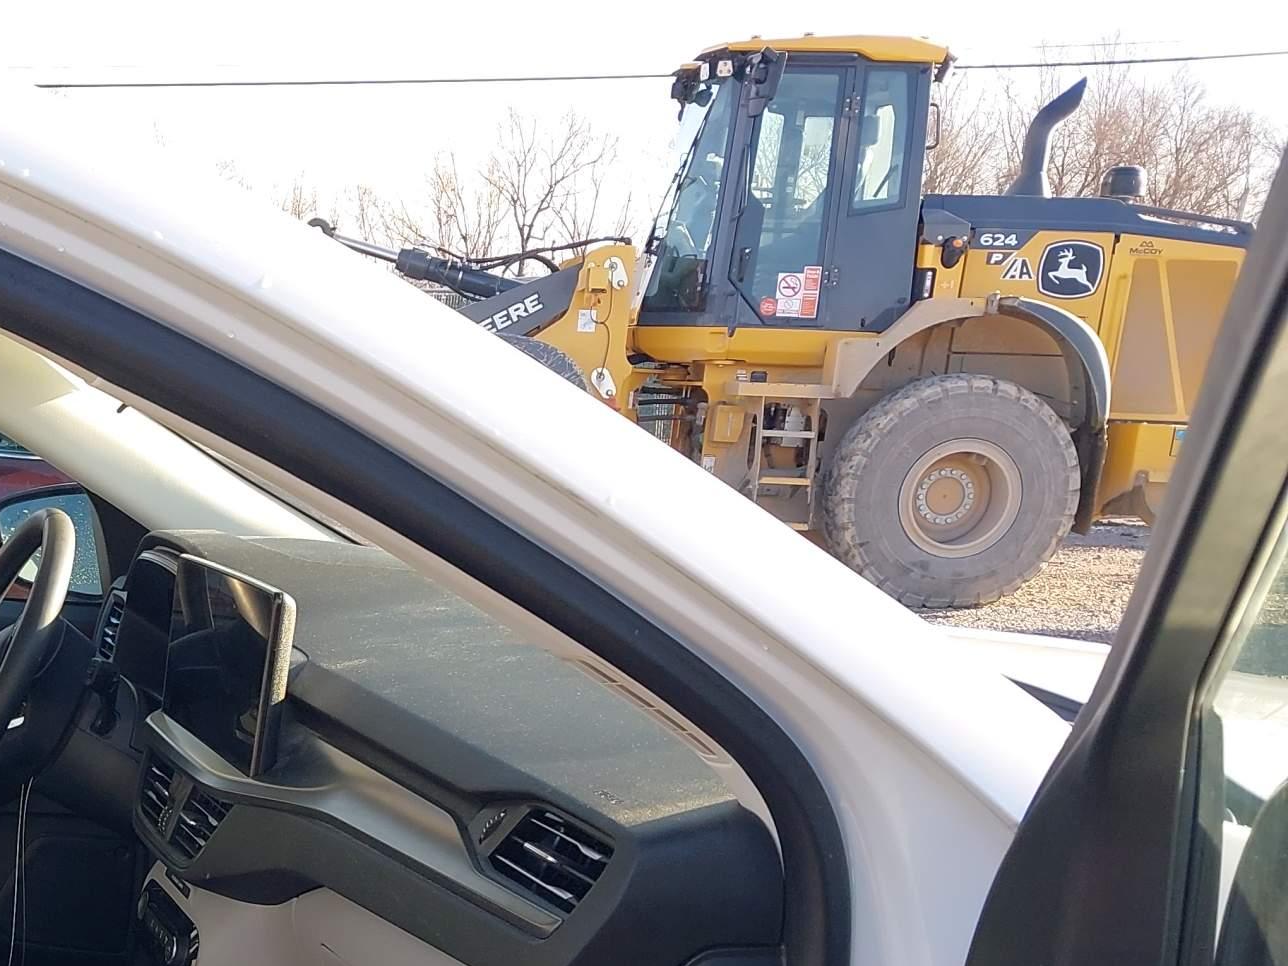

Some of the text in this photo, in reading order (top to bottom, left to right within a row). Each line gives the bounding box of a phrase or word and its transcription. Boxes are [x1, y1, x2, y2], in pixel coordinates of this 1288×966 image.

[980, 233, 1018, 246] 624
[990, 253, 1004, 264] P
[478, 294, 544, 333] EERE
